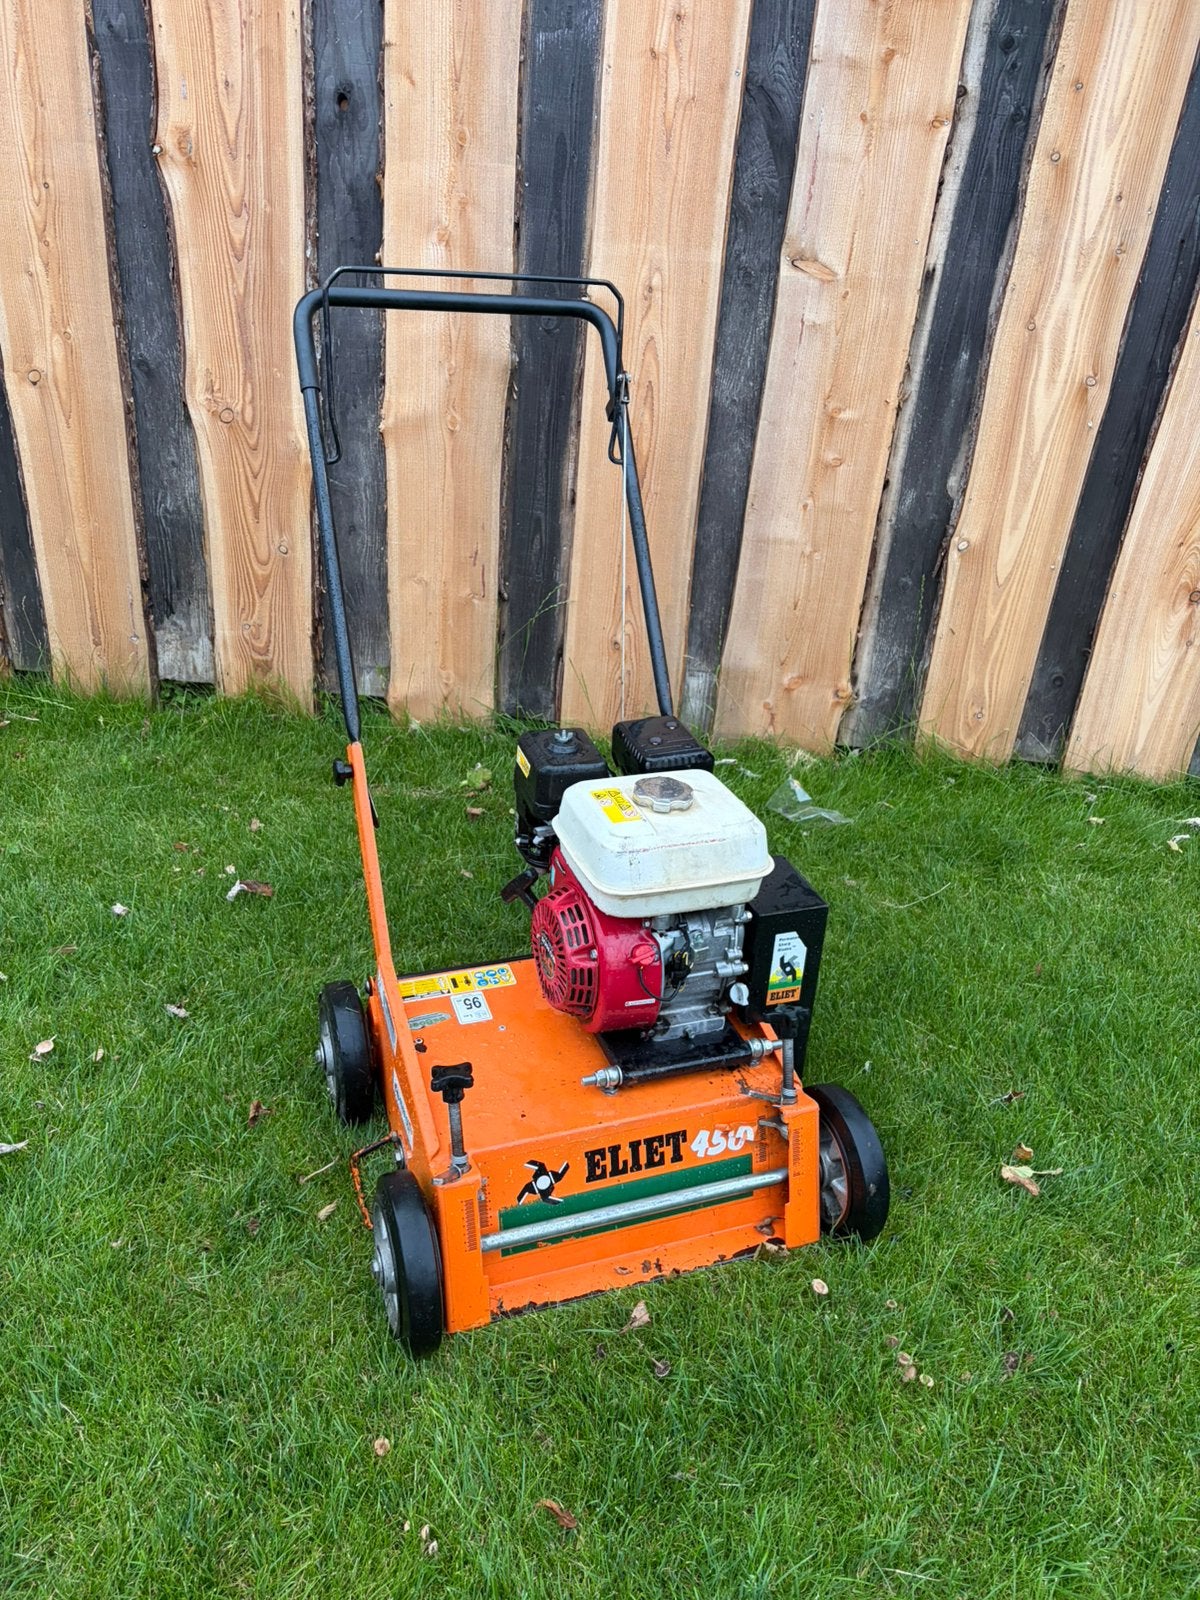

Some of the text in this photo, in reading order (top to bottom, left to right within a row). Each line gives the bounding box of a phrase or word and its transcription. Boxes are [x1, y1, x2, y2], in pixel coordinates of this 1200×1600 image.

[769, 989, 797, 1001] ELIET
[463, 997, 482, 1010] 95
[585, 1130, 687, 1183] ELIET
